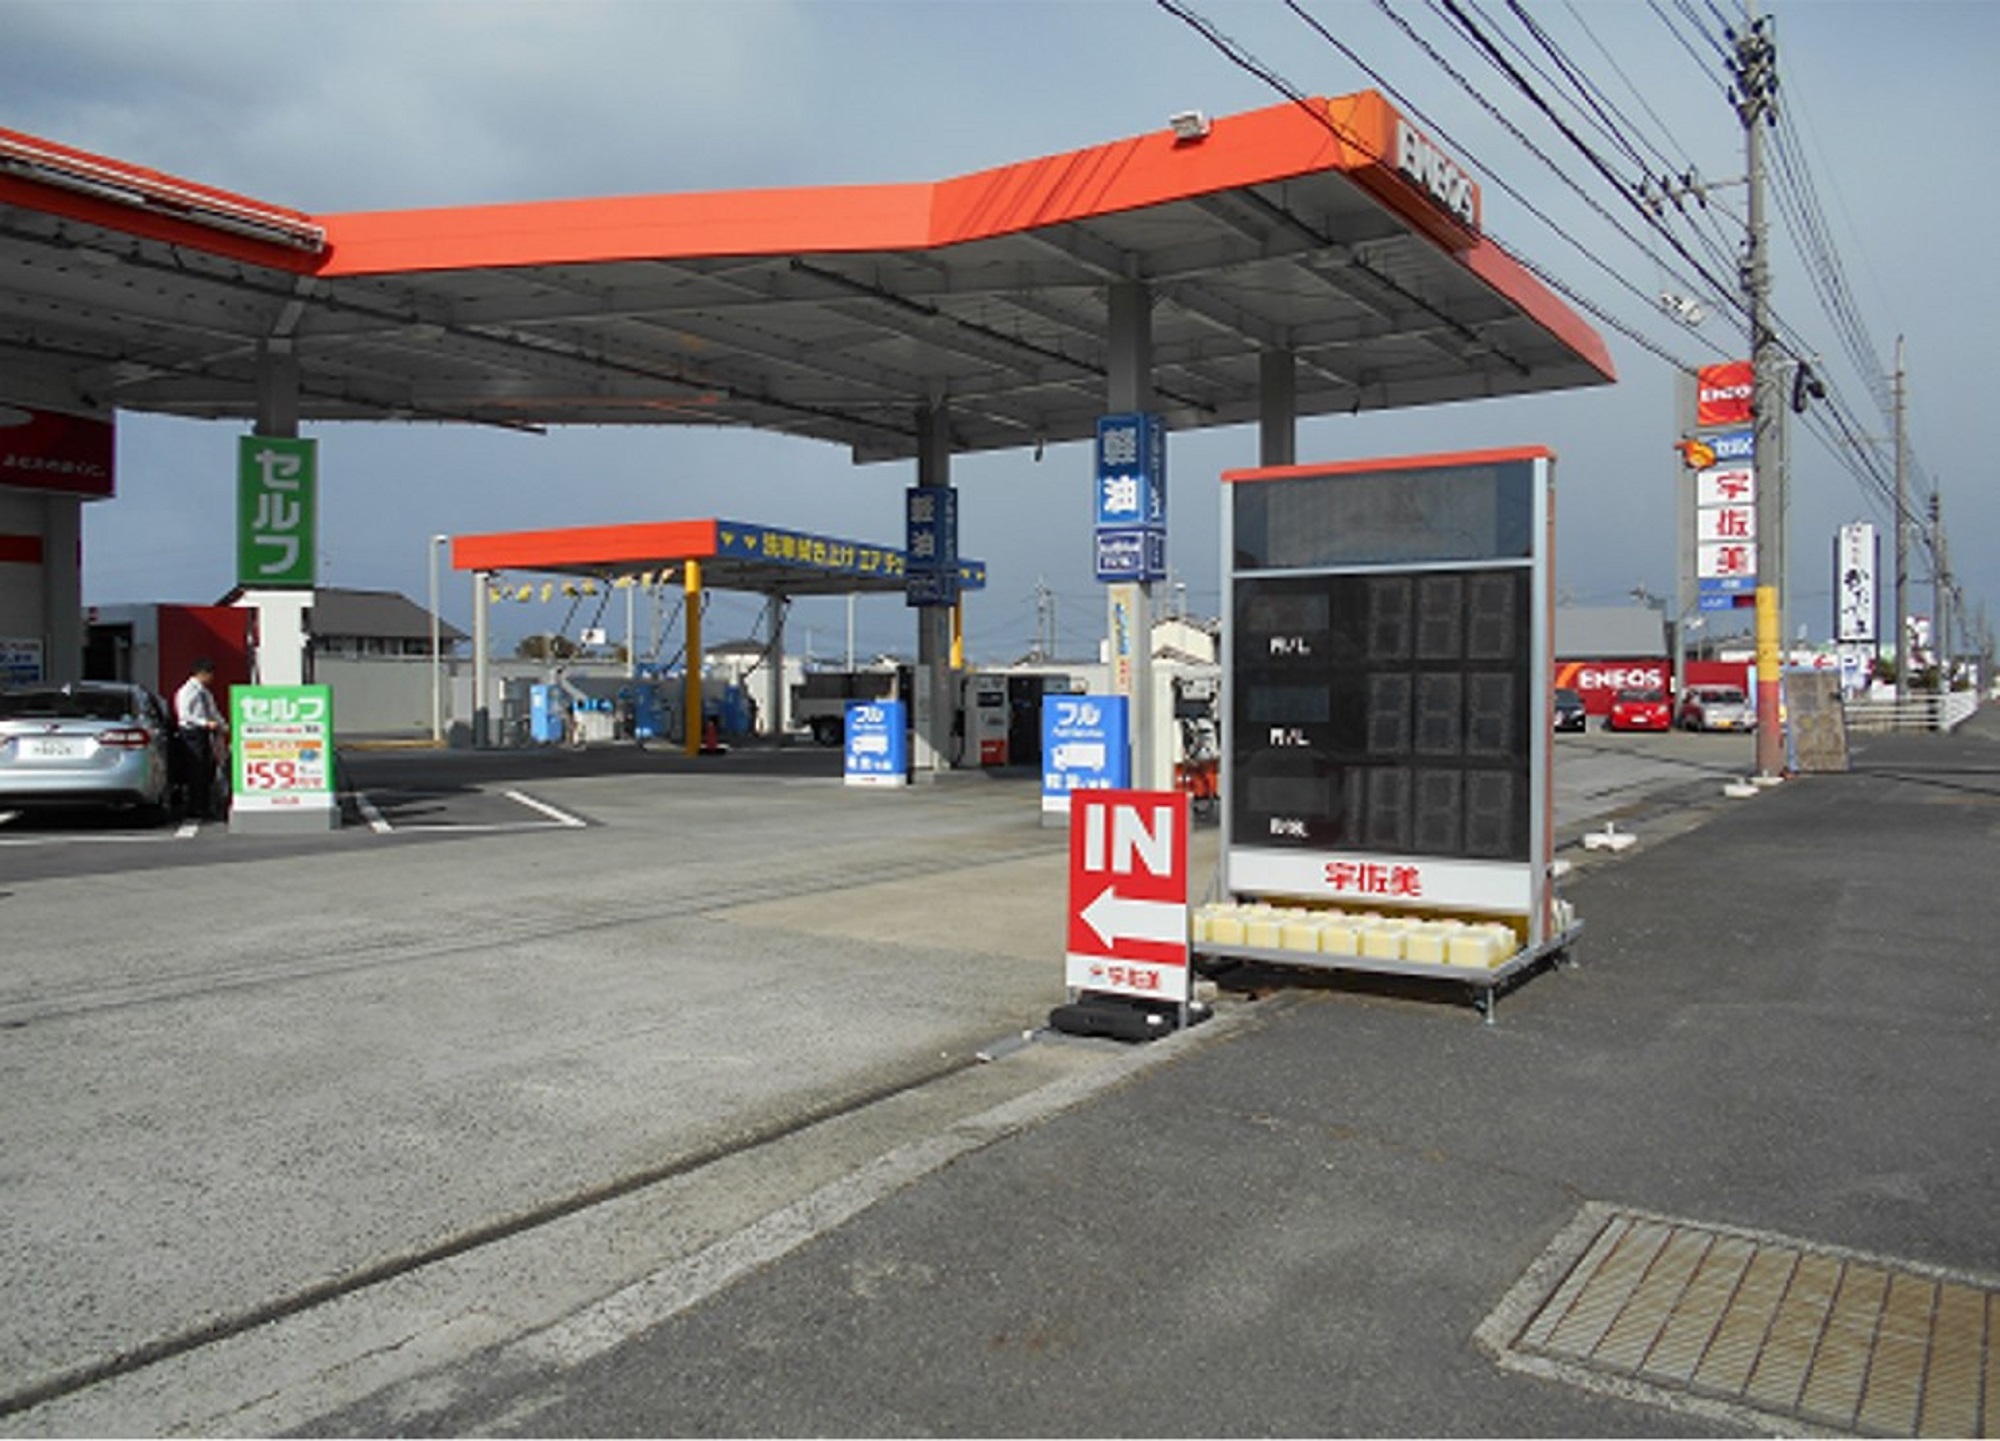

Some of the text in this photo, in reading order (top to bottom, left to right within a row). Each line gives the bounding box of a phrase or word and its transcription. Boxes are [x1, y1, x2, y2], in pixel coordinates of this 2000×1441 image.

[1396, 119, 1475, 224] ENEOS
[1701, 385, 1752, 402] ENEO
[1103, 426, 1138, 514] 軽油
[253, 449, 301, 574] セルフ
[1716, 470, 1749, 574] 宇佐美
[1579, 667, 1662, 689] ENEOS
[241, 695, 325, 721] セルフ
[853, 706, 885, 723] フル
[1057, 702, 1101, 727] フル
[1085, 804, 1173, 878] IN
[1324, 862, 1422, 896] 宇佐美
